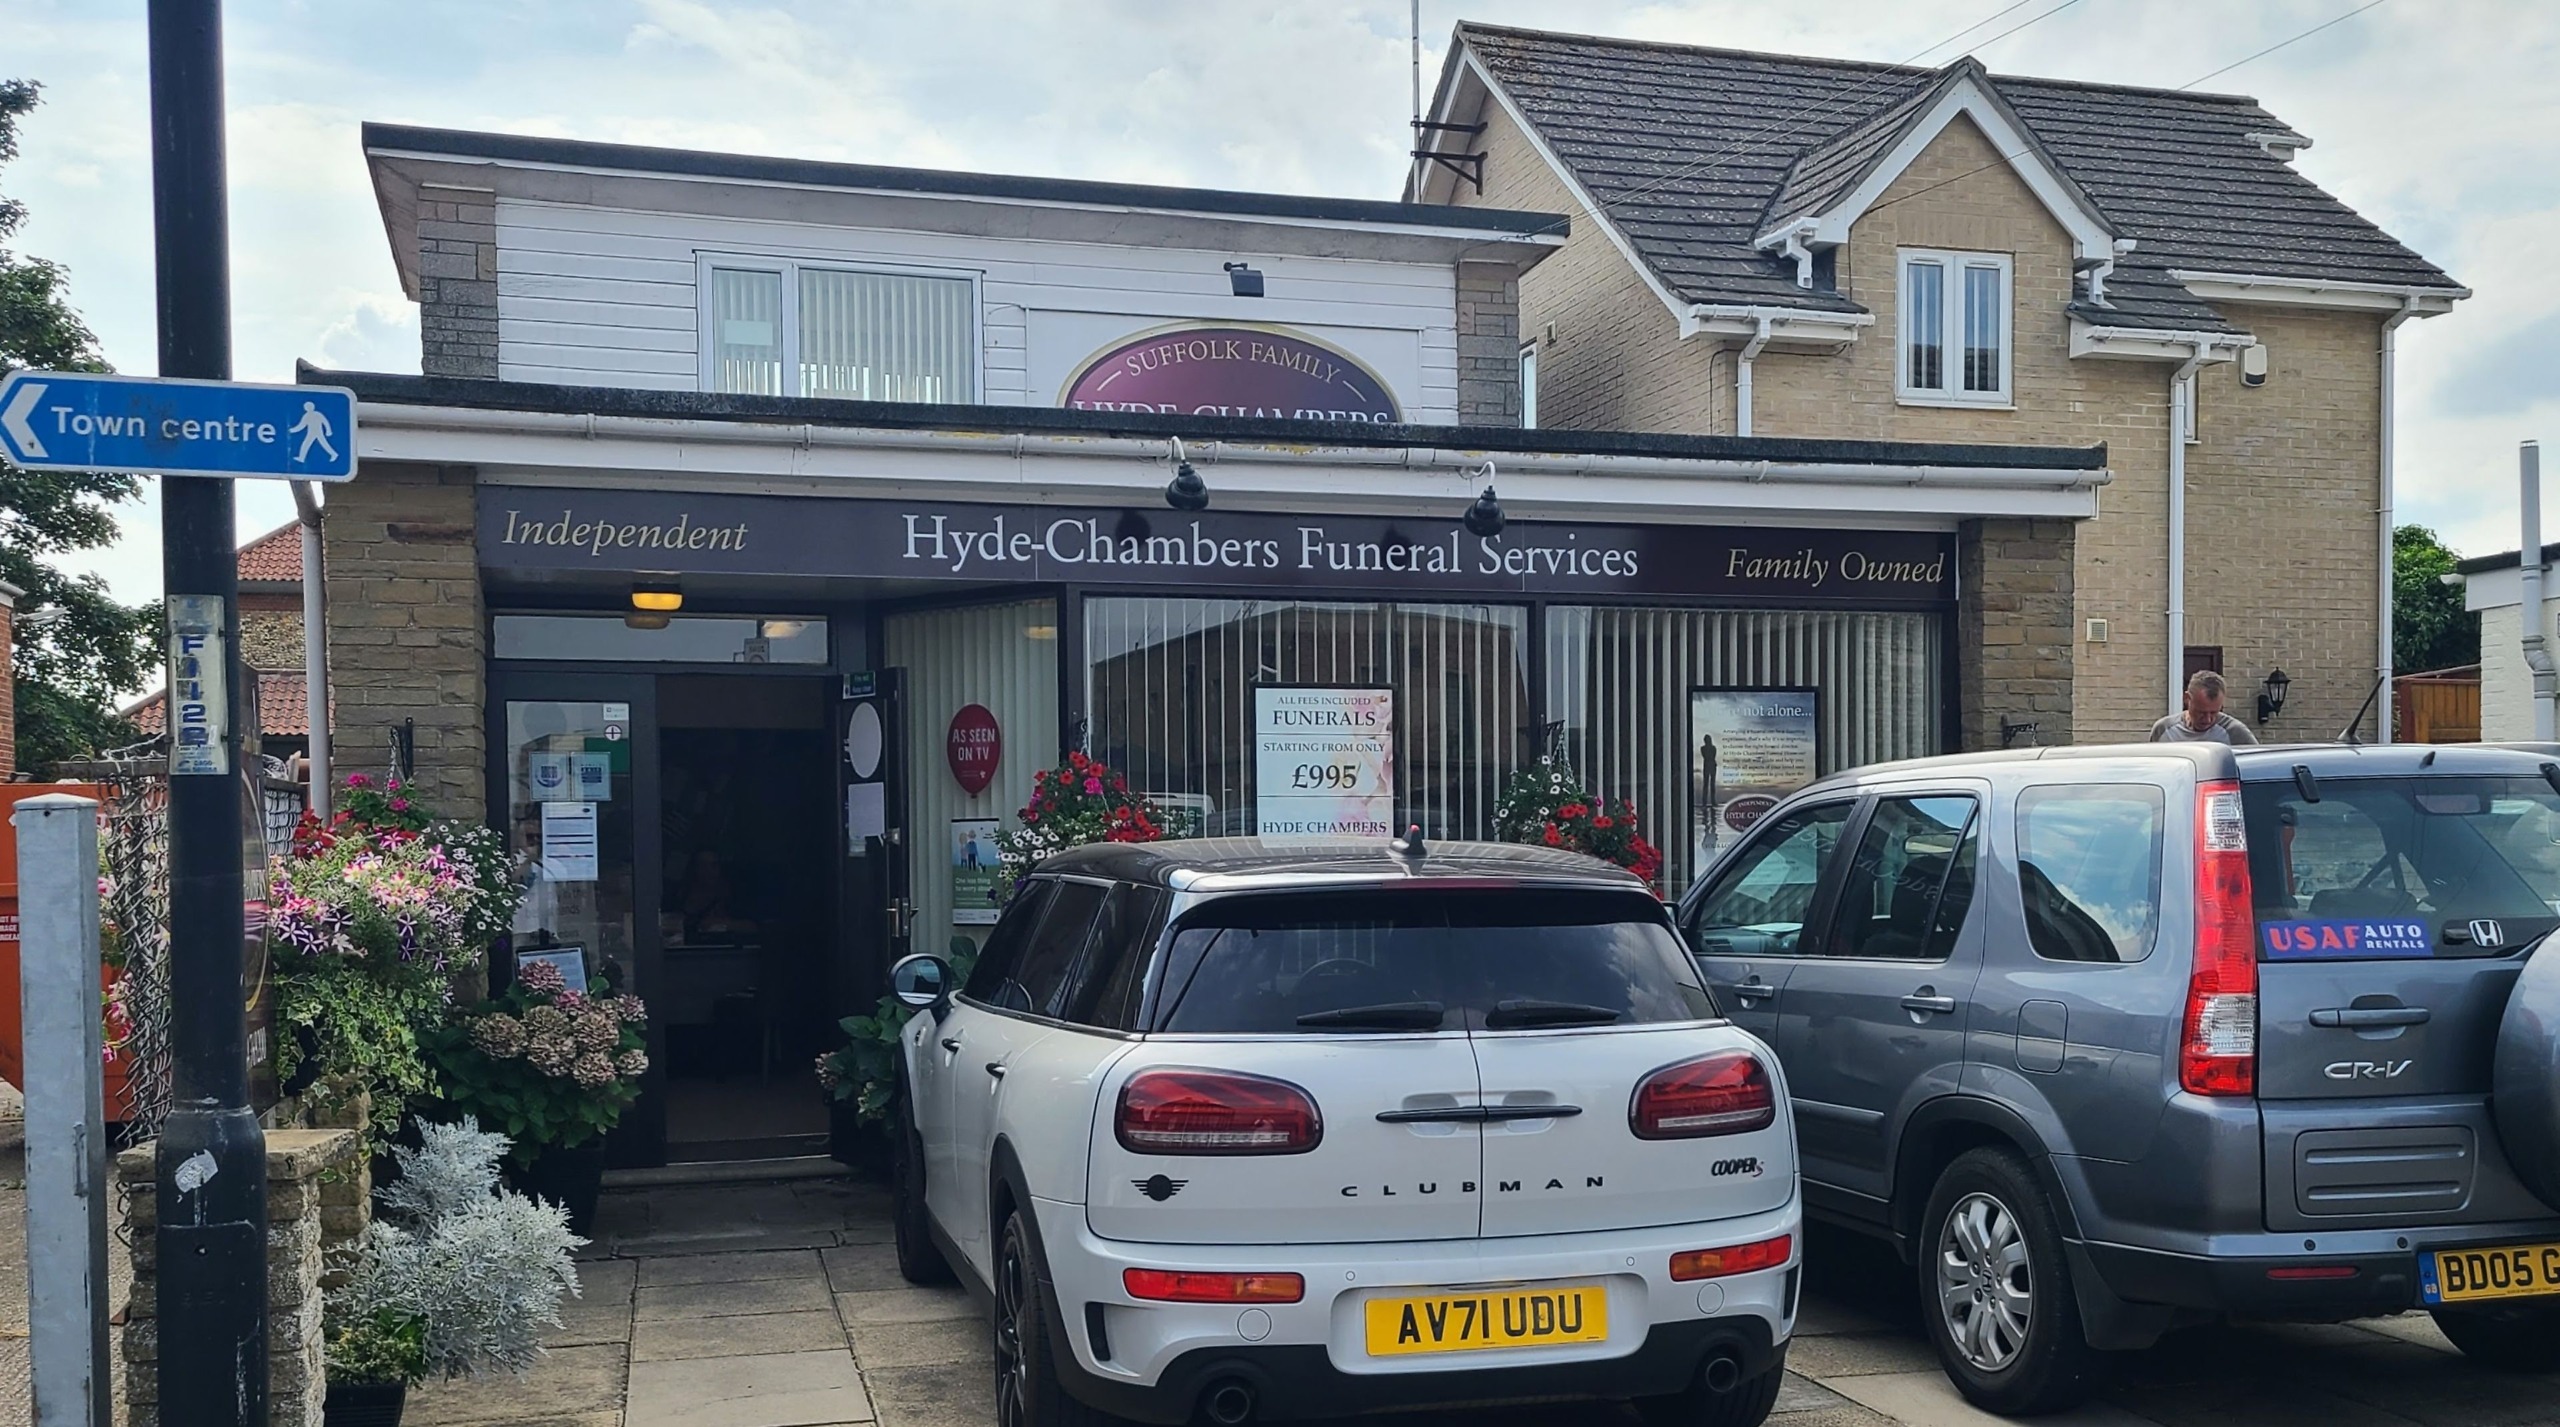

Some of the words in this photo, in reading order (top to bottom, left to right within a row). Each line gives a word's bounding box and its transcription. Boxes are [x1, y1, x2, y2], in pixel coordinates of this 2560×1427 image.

[1126, 340, 1243, 377] SUFFOLK
[1250, 341, 1341, 384] FAMILY
[51, 405, 146, 437] Town
[161, 415, 277, 444] centre
[502, 510, 749, 556] Independent
[902, 514, 1280, 572] Hyde-Chambers
[1297, 527, 1462, 573] Funeral
[1478, 532, 1639, 577] Services
[1725, 549, 1829, 587] Family
[1840, 551, 1945, 583] Owned
[1277, 696, 1298, 705] ALL
[1298, 696, 1319, 705] FEES
[1321, 697, 1371, 706] INCLUDED
[1272, 710, 1376, 727] FUNERALS
[953, 728, 967, 743] AS
[969, 727, 995, 743] SEEN
[958, 746, 973, 761] ON
[976, 746, 989, 760] TV
[1263, 742, 1319, 752] STARTING
[1322, 742, 1353, 752] FROM
[1356, 743, 1386, 752] ONLY
[1291, 763, 1357, 789] £995
[1263, 821, 1303, 833] HYDE
[1306, 821, 1387, 833] CHAMBERS
[2268, 925, 2361, 951] USAF
[2364, 924, 2422, 938] AUTO
[2366, 939, 2425, 950] RENTALS
[2323, 1060, 2413, 1081] CR-V
[1341, 1176, 1603, 1197] CLUBMAN
[2443, 1250, 2534, 1292] BD05
[1398, 1299, 1490, 1345] AV71
[1502, 1293, 1582, 1337] UDU
